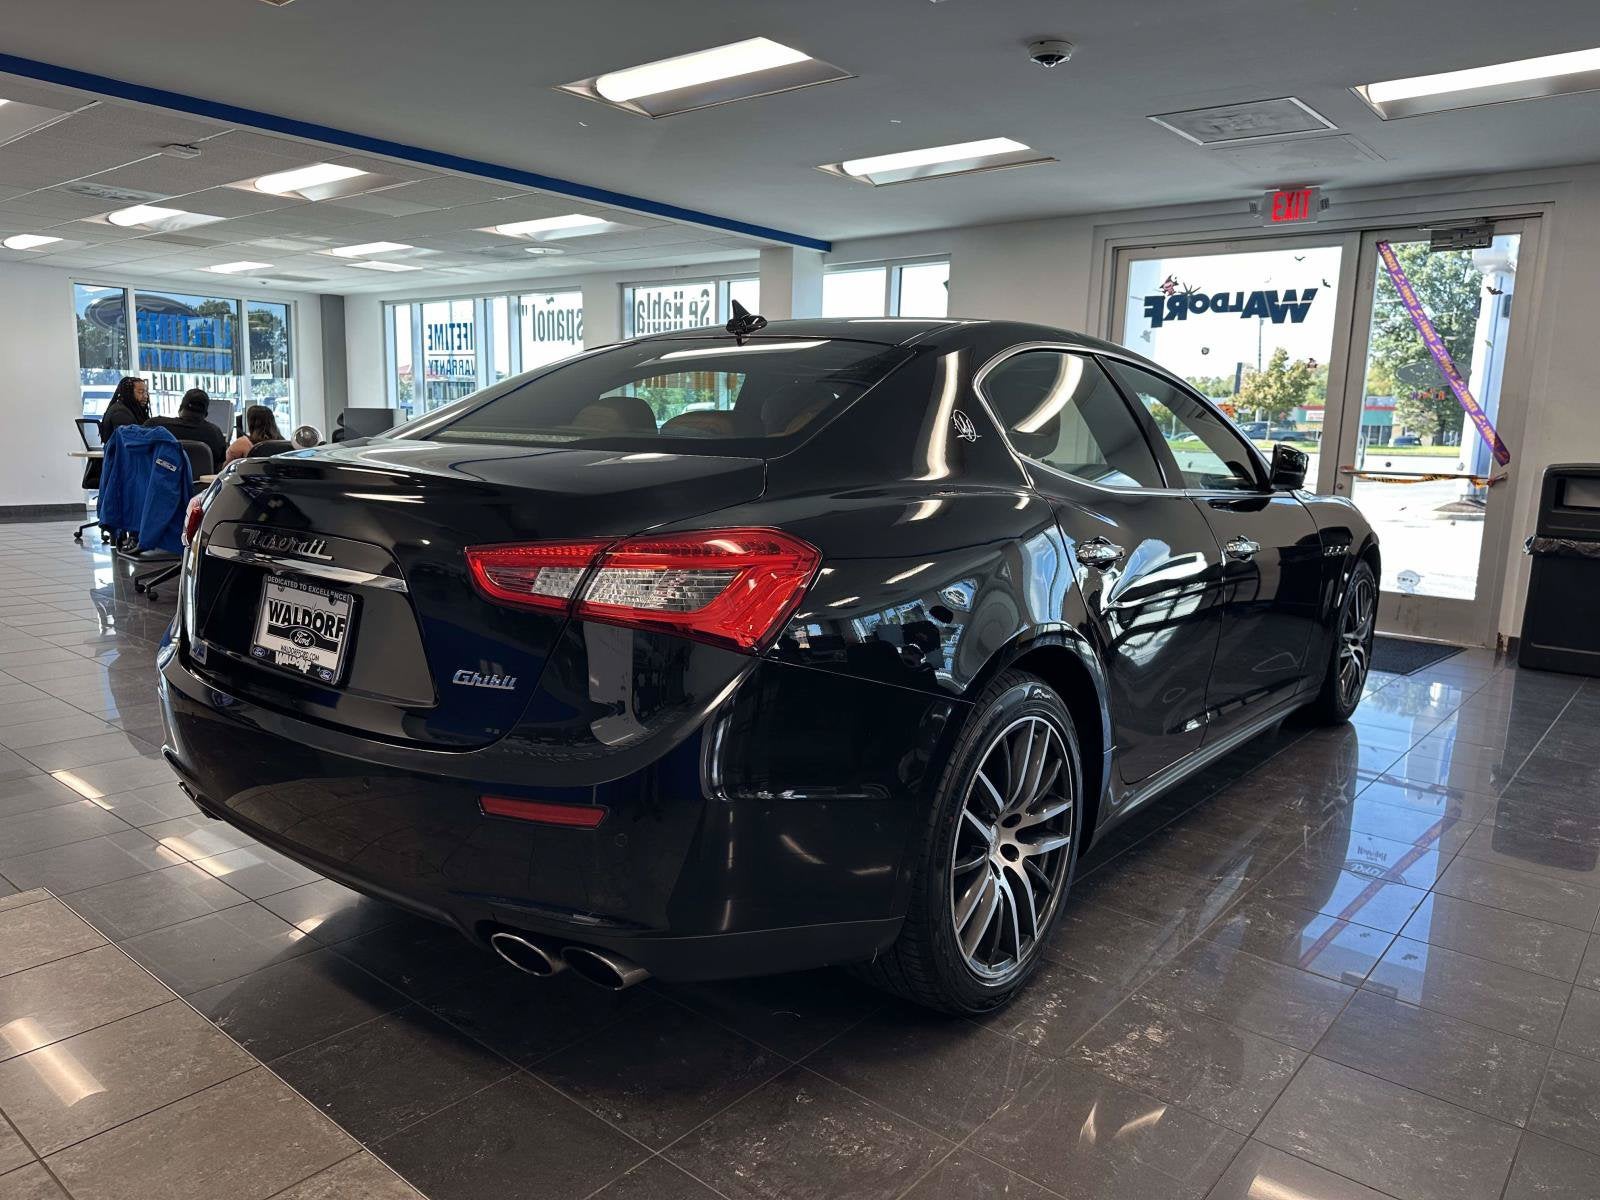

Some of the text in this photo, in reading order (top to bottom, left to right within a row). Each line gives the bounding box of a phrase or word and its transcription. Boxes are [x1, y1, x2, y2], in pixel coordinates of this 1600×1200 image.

[1272, 189, 1313, 222] EXIT
[267, 576, 347, 601] DEDICATED TO EXCELLENCE
[268, 600, 346, 640] WALDORF
[294, 630, 312, 647] Ford
[275, 651, 312, 674] WALDORF
[453, 669, 517, 690] Ghibli
